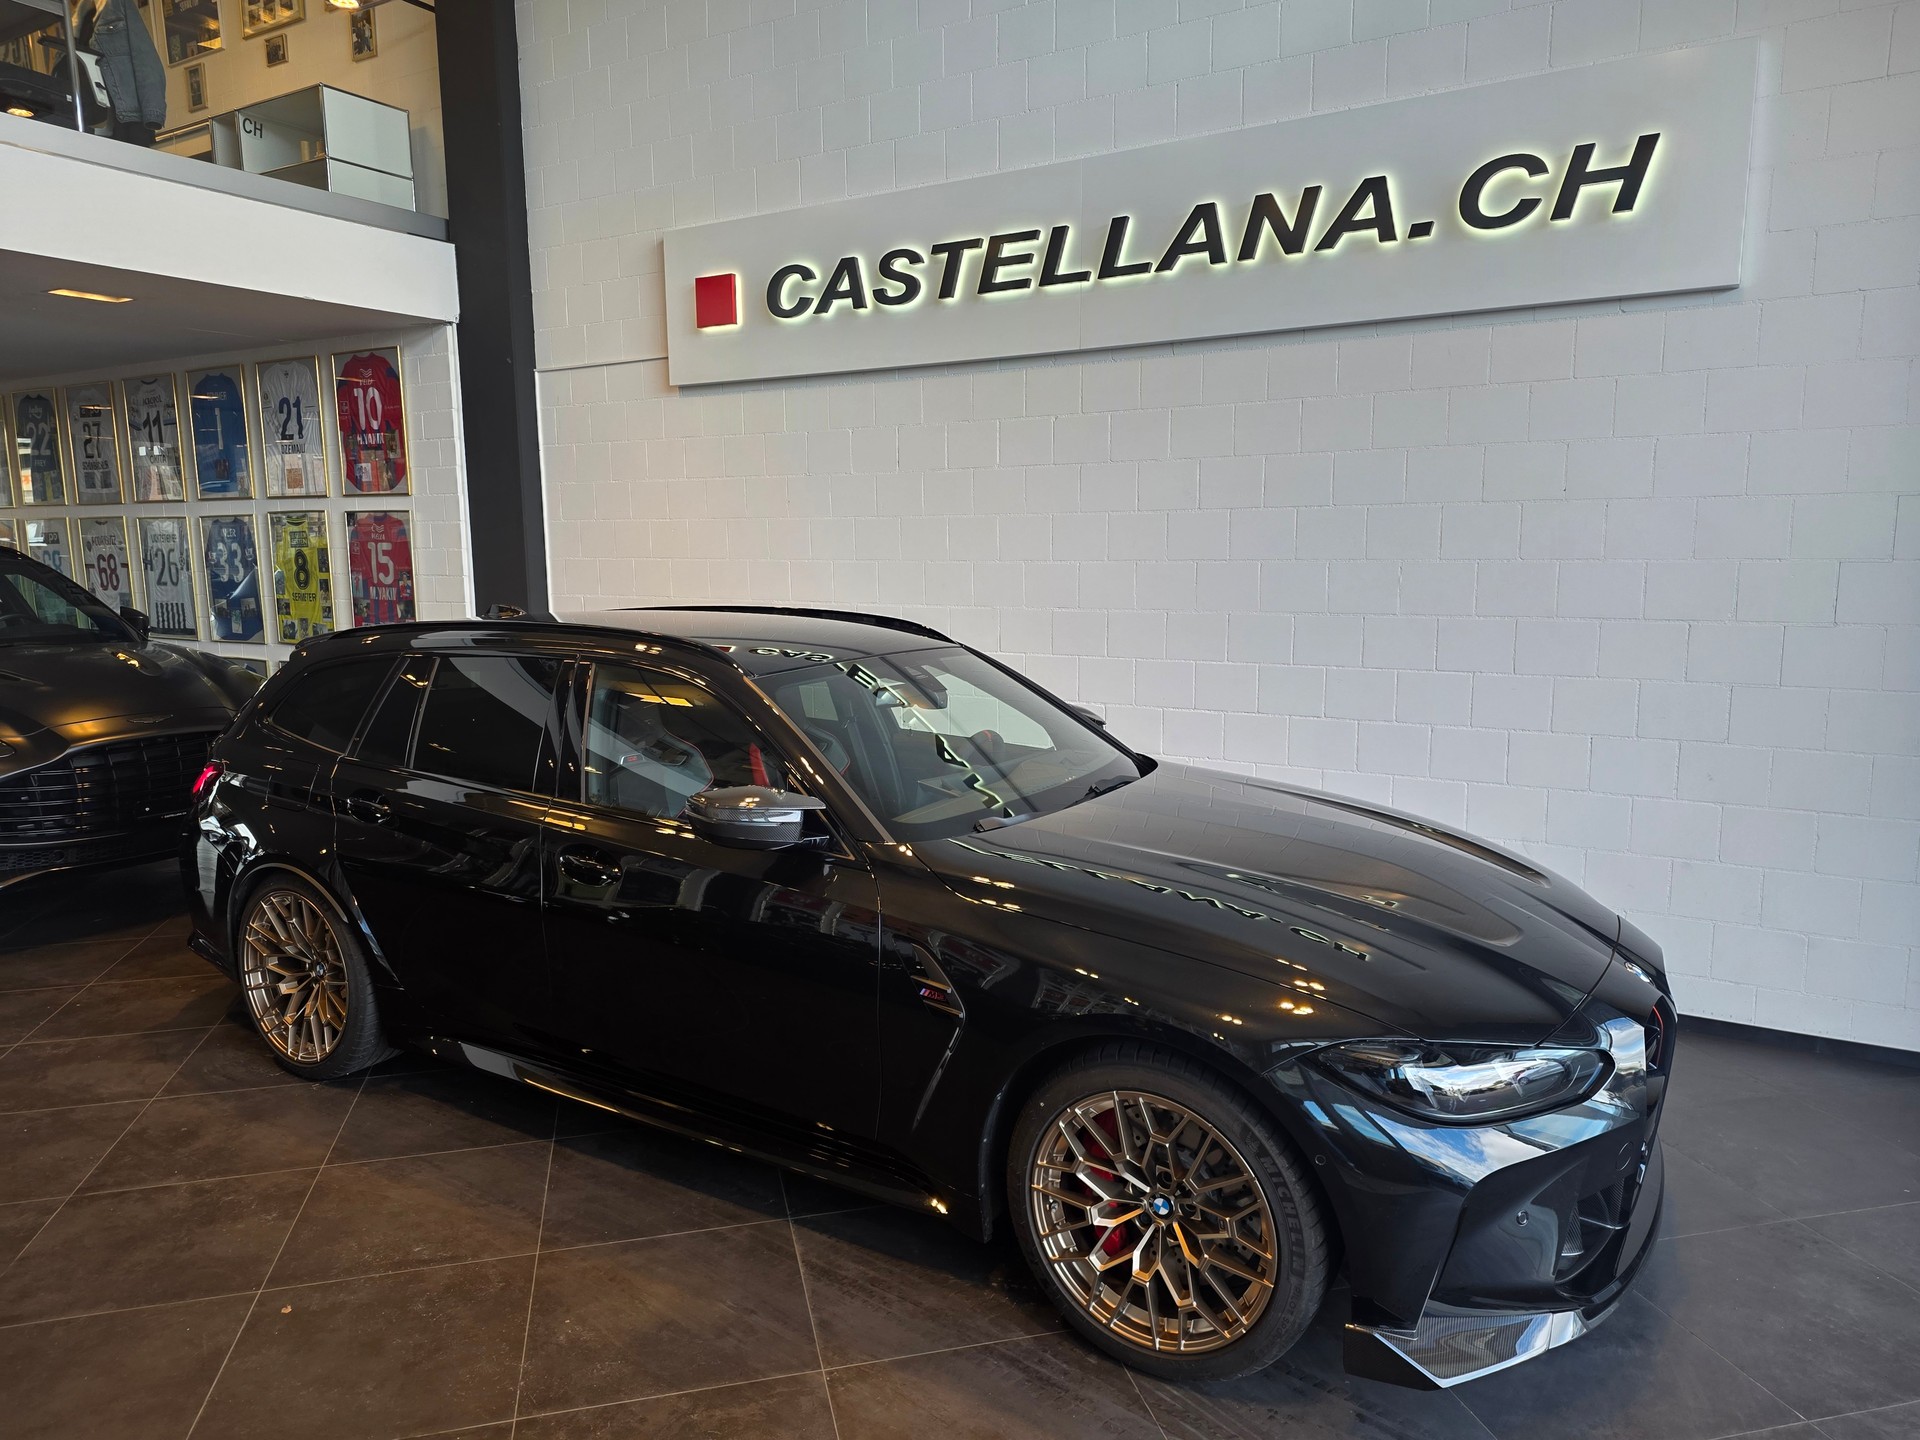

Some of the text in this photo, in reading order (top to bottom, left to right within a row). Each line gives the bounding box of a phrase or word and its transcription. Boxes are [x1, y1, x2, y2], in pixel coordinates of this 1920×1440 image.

[243, 118, 263, 138] CH
[767, 132, 1662, 321] CASTELLANA.CH
[279, 397, 303, 440] 21
[354, 387, 382, 430] 10
[26, 422, 51, 456] 22
[82, 420, 102, 459] 27
[142, 410, 164, 451] 11
[96, 553, 120, 592] 68
[155, 548, 180, 587] 26
[216, 542, 244, 583] 33
[293, 548, 311, 590] 8
[367, 541, 395, 585] 15
[1259, 1155, 1304, 1272] MICHELIN
